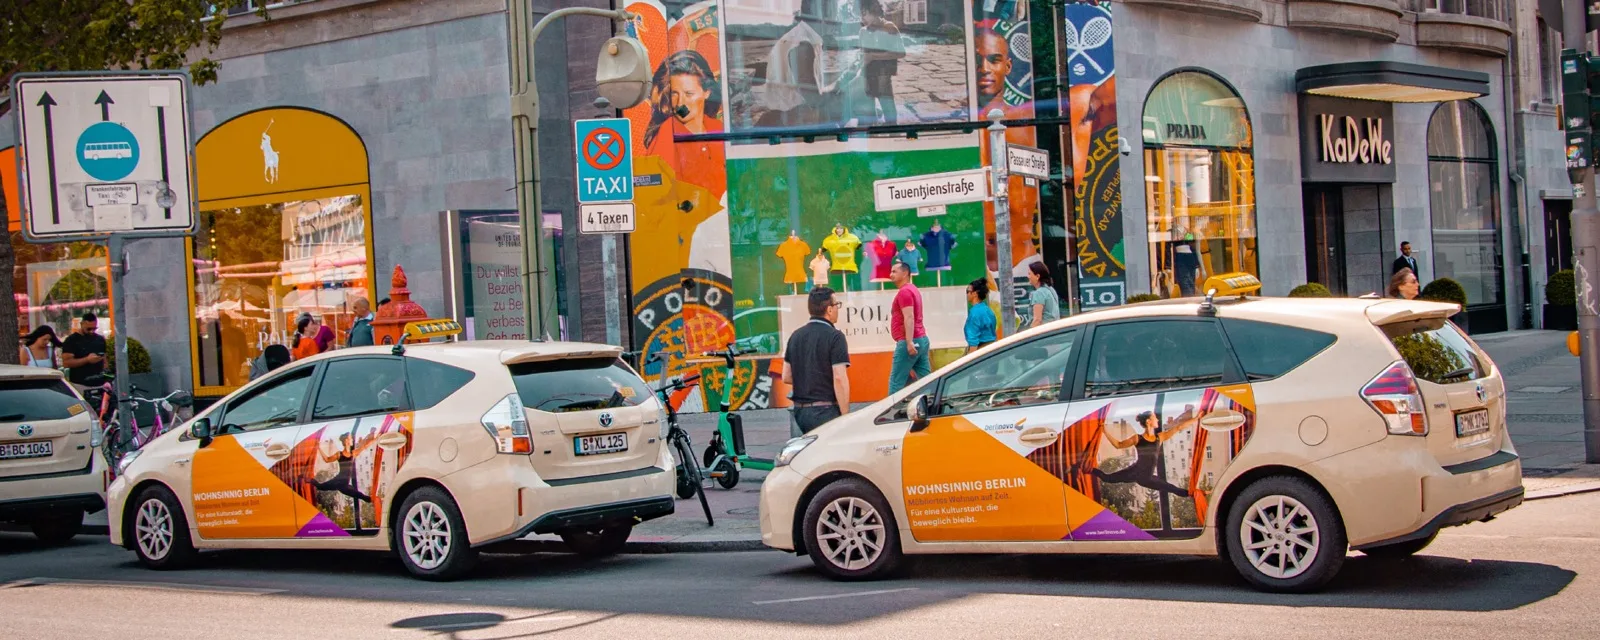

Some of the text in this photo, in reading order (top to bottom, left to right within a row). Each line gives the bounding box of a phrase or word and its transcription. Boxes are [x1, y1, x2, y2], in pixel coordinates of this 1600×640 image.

[695, 11, 718, 30] ES
[1166, 123, 1207, 139] PRADA
[1321, 113, 1391, 164] KaDeWe
[1009, 151, 1046, 173] Passauer Straße
[583, 176, 627, 194] TAXI
[888, 178, 974, 200] Tauentzienstraße
[587, 211, 629, 225] 4 Taxen
[477, 265, 519, 279] Du willst
[493, 301, 505, 311] zu
[638, 287, 722, 330] POLO
[421, 321, 456, 333] TAXI
[843, 327, 868, 336] LPH
[0, 443, 51, 456] B BC 1061
[583, 435, 624, 450] B XL 125
[906, 477, 1027, 496] WOHNSINNIG BERLIN
[193, 487, 270, 501] WOHNSINNIG BERLIN
[910, 507, 922, 516] Für
[924, 506, 940, 515] eine
[941, 504, 985, 514] Kulturstadt,
[913, 515, 978, 527] beweglich bleibt.
